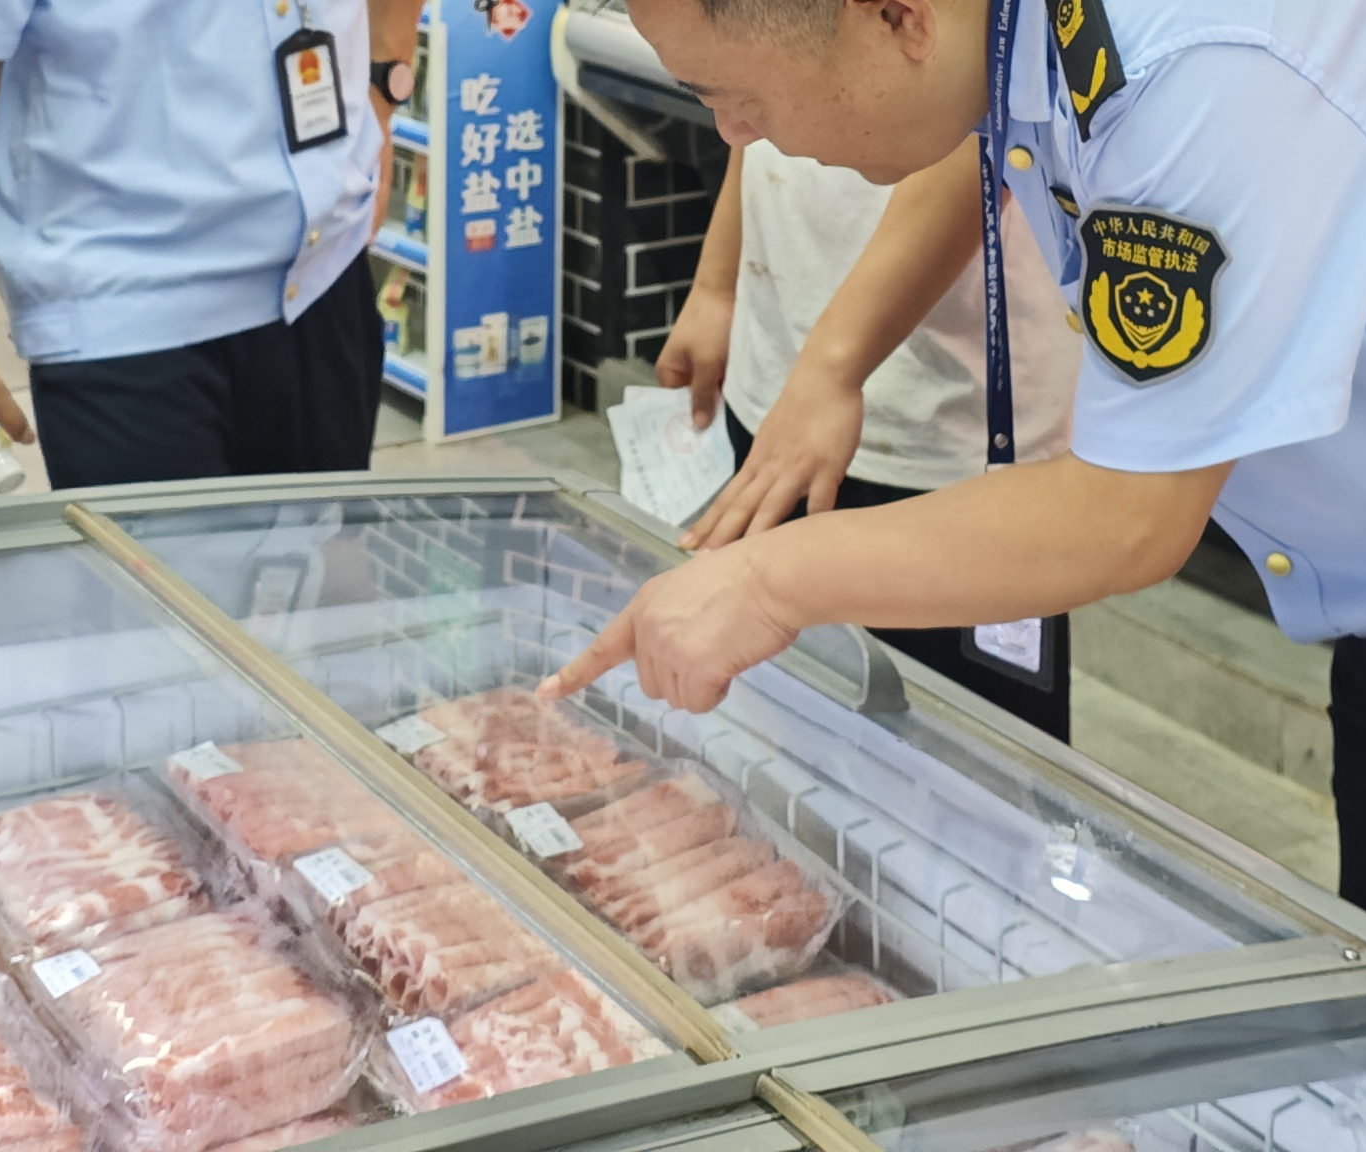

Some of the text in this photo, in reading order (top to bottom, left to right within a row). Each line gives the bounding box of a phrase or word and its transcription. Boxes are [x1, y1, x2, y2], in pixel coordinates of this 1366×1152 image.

[995, 36, 1006, 59] Law
[461, 74, 502, 214] 吃好盐
[504, 111, 544, 250] 选中盐
[1092, 216, 1211, 256] 中华人民共和国
[1102, 237, 1199, 274] 市场监管执法
